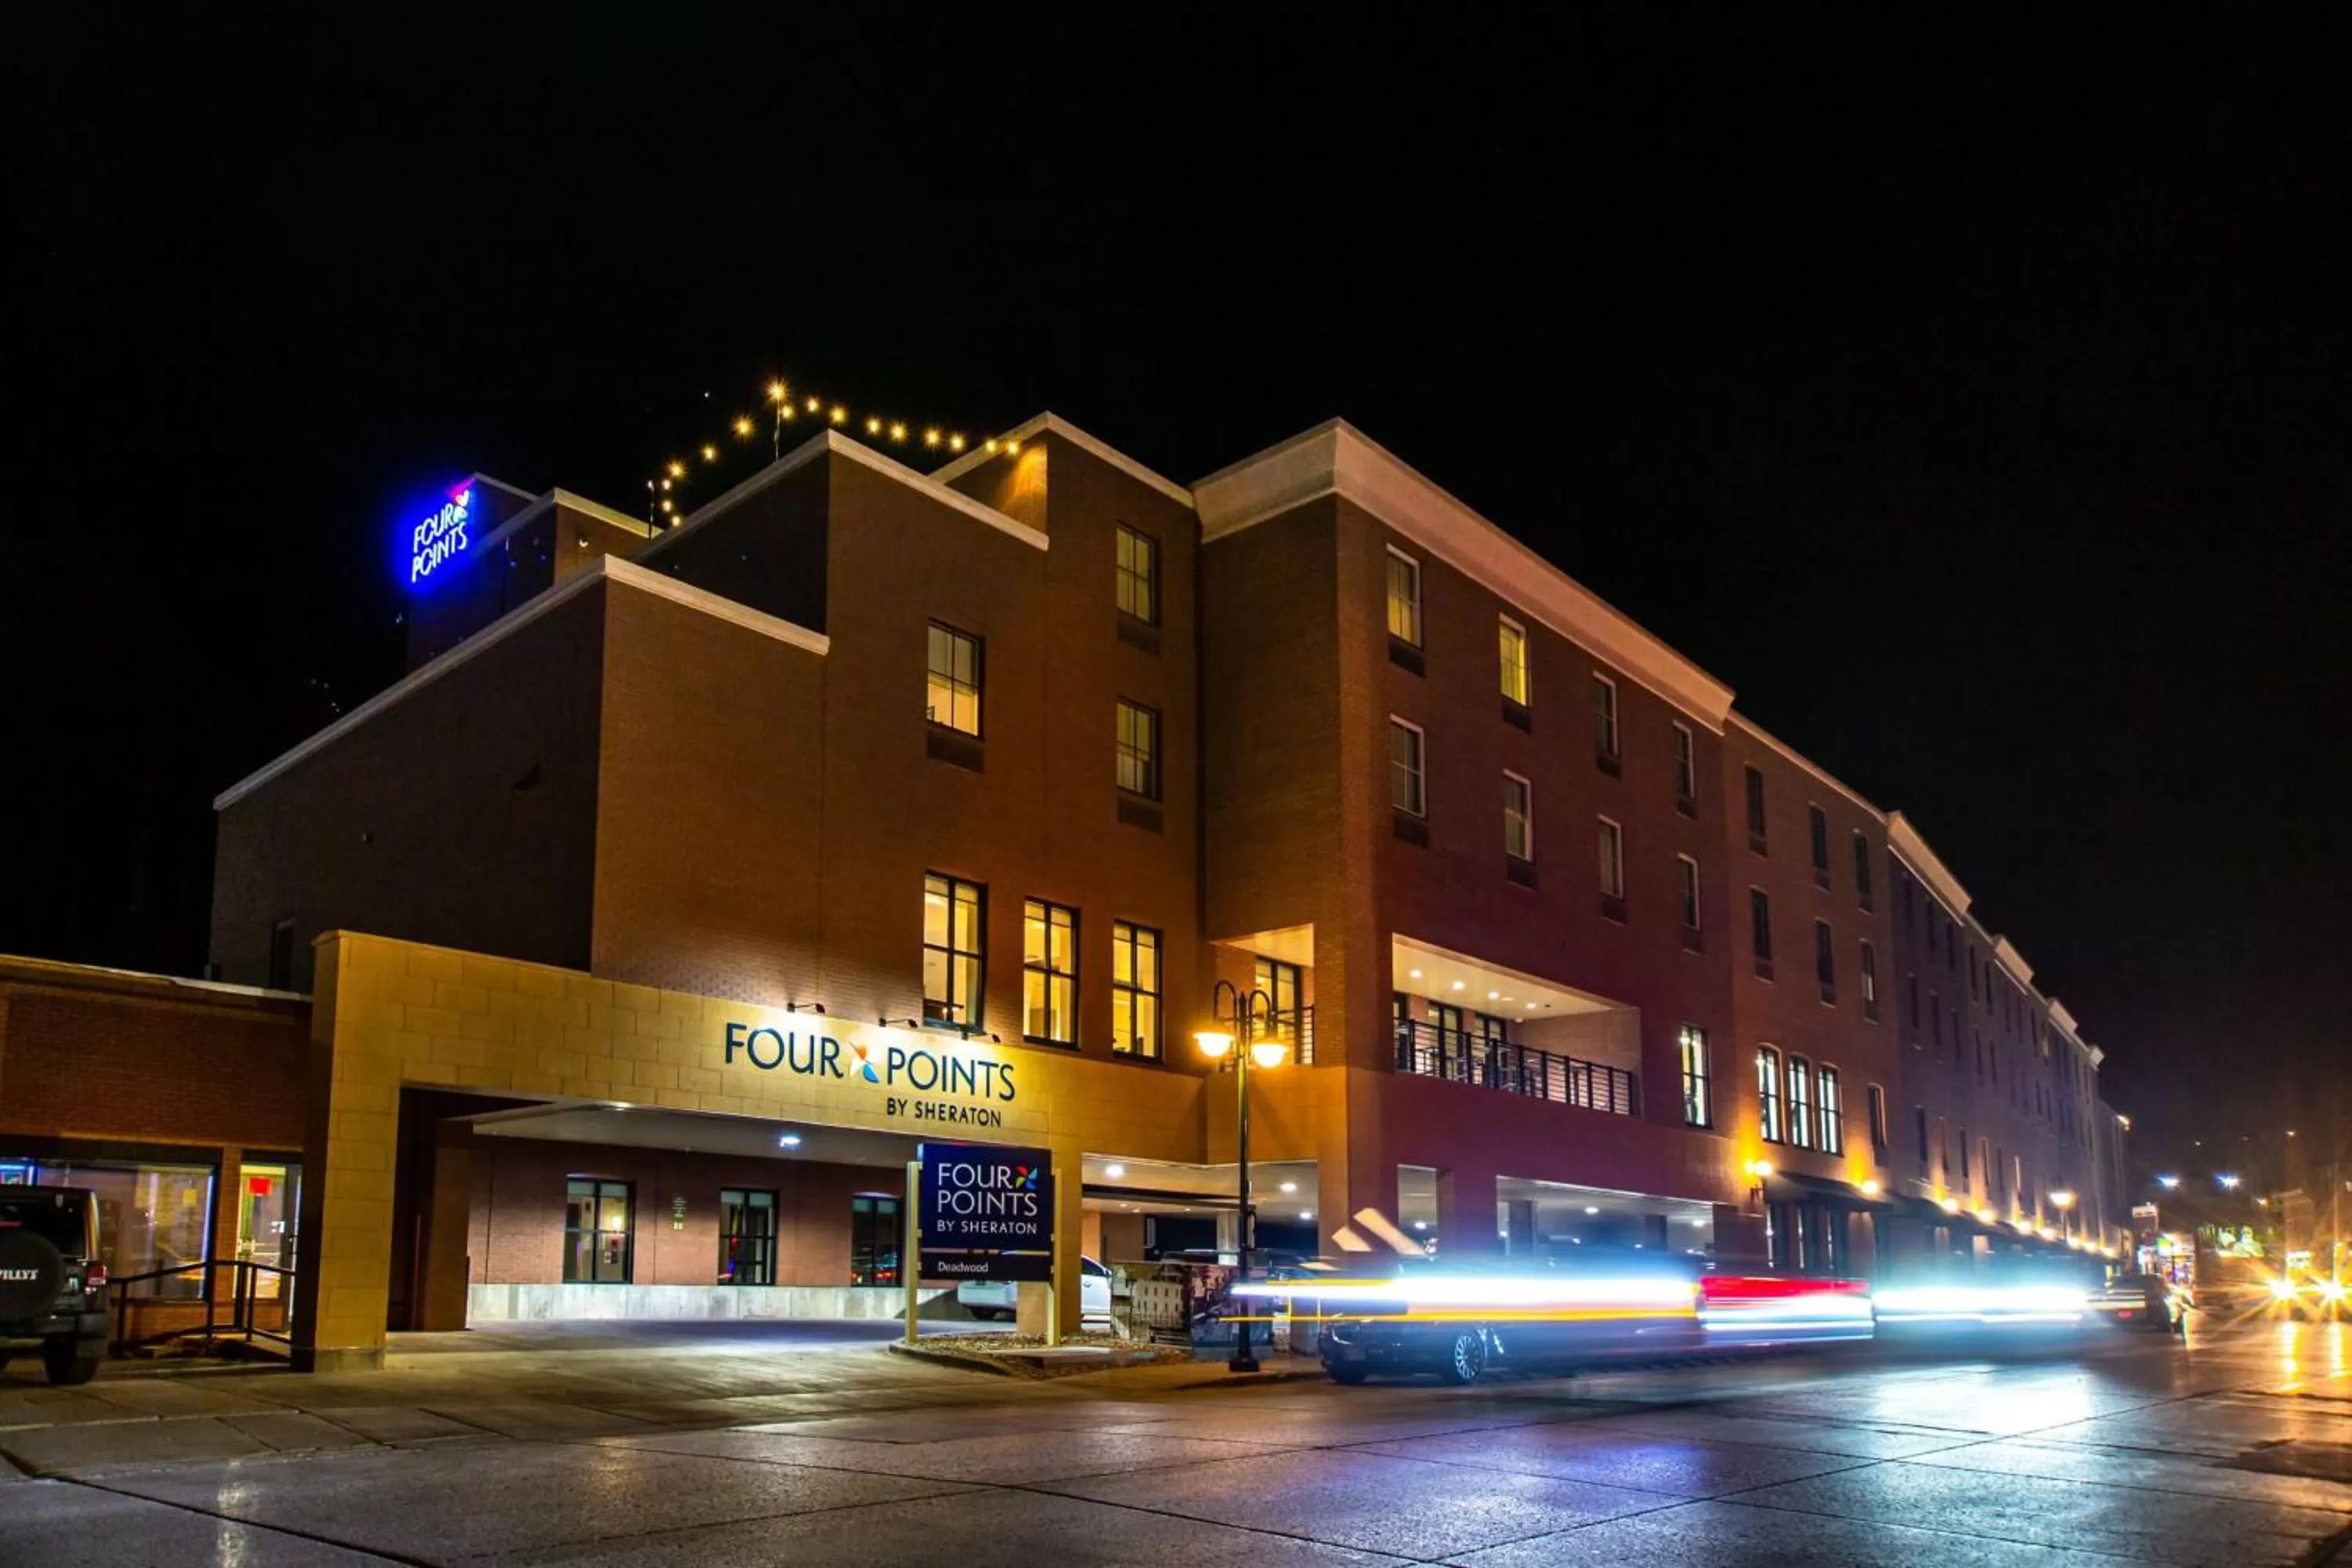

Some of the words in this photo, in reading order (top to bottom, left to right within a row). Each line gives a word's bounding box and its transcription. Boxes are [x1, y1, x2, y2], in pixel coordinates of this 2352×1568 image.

[414, 503, 454, 553] FOUR
[412, 521, 467, 583] POINTS
[725, 1022, 844, 1079] FOUR
[887, 1047, 1015, 1102] POINTS
[887, 1098, 908, 1116] BY
[915, 1101, 1002, 1127] SHERATON
[938, 1163, 1014, 1189] FOUR
[937, 1189, 1038, 1217] POINTS
[937, 1219, 955, 1232] BY
[960, 1221, 1037, 1234] SHERATON
[938, 1261, 989, 1272] Deadwood
